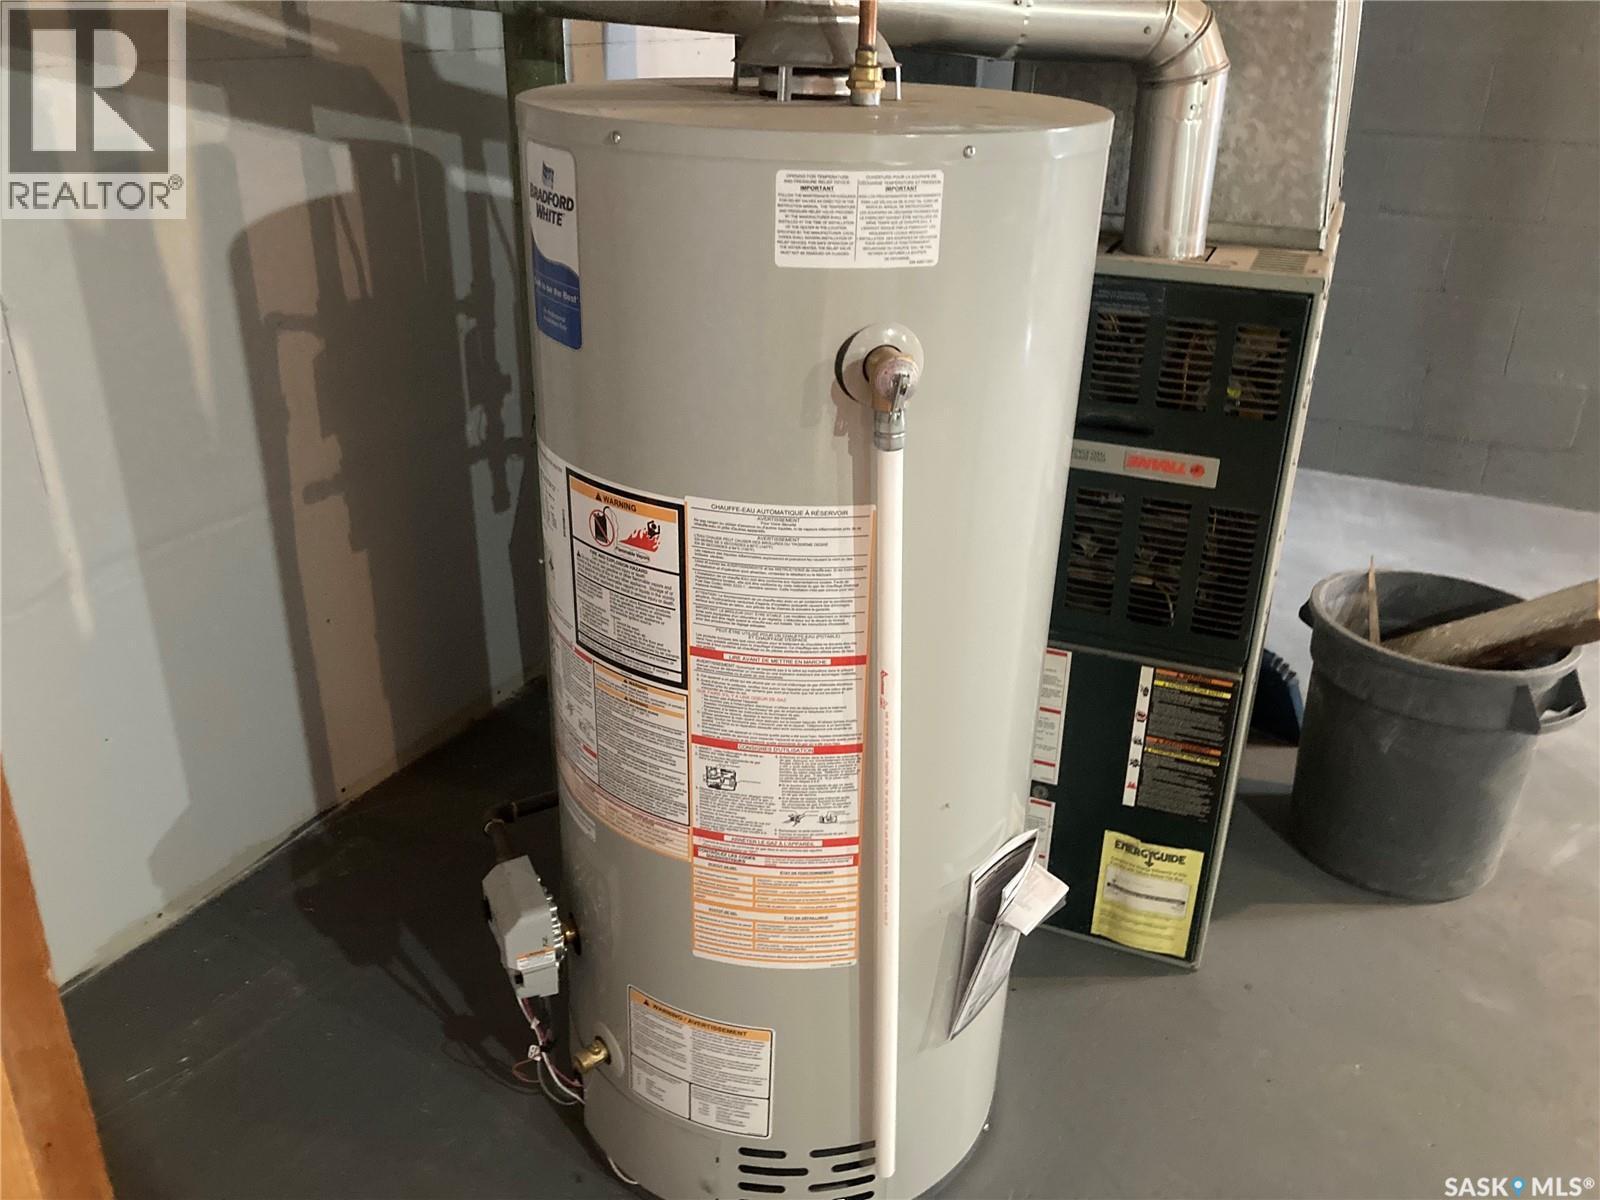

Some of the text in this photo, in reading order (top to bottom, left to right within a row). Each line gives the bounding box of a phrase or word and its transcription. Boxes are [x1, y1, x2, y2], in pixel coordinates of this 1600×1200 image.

[530, 182, 574, 211] BRADFORD
[536, 202, 563, 227] WHITE
[603, 495, 636, 512] WARNING
[711, 504, 755, 513] CHAUFFE-EAU
[757, 508, 803, 516] AUTOMATIQUE
[1114, 839, 1187, 865] ENERGYGUIDE
[652, 1004, 682, 1021] WARNING
[688, 1019, 748, 1036] AVERTISSEMENT
